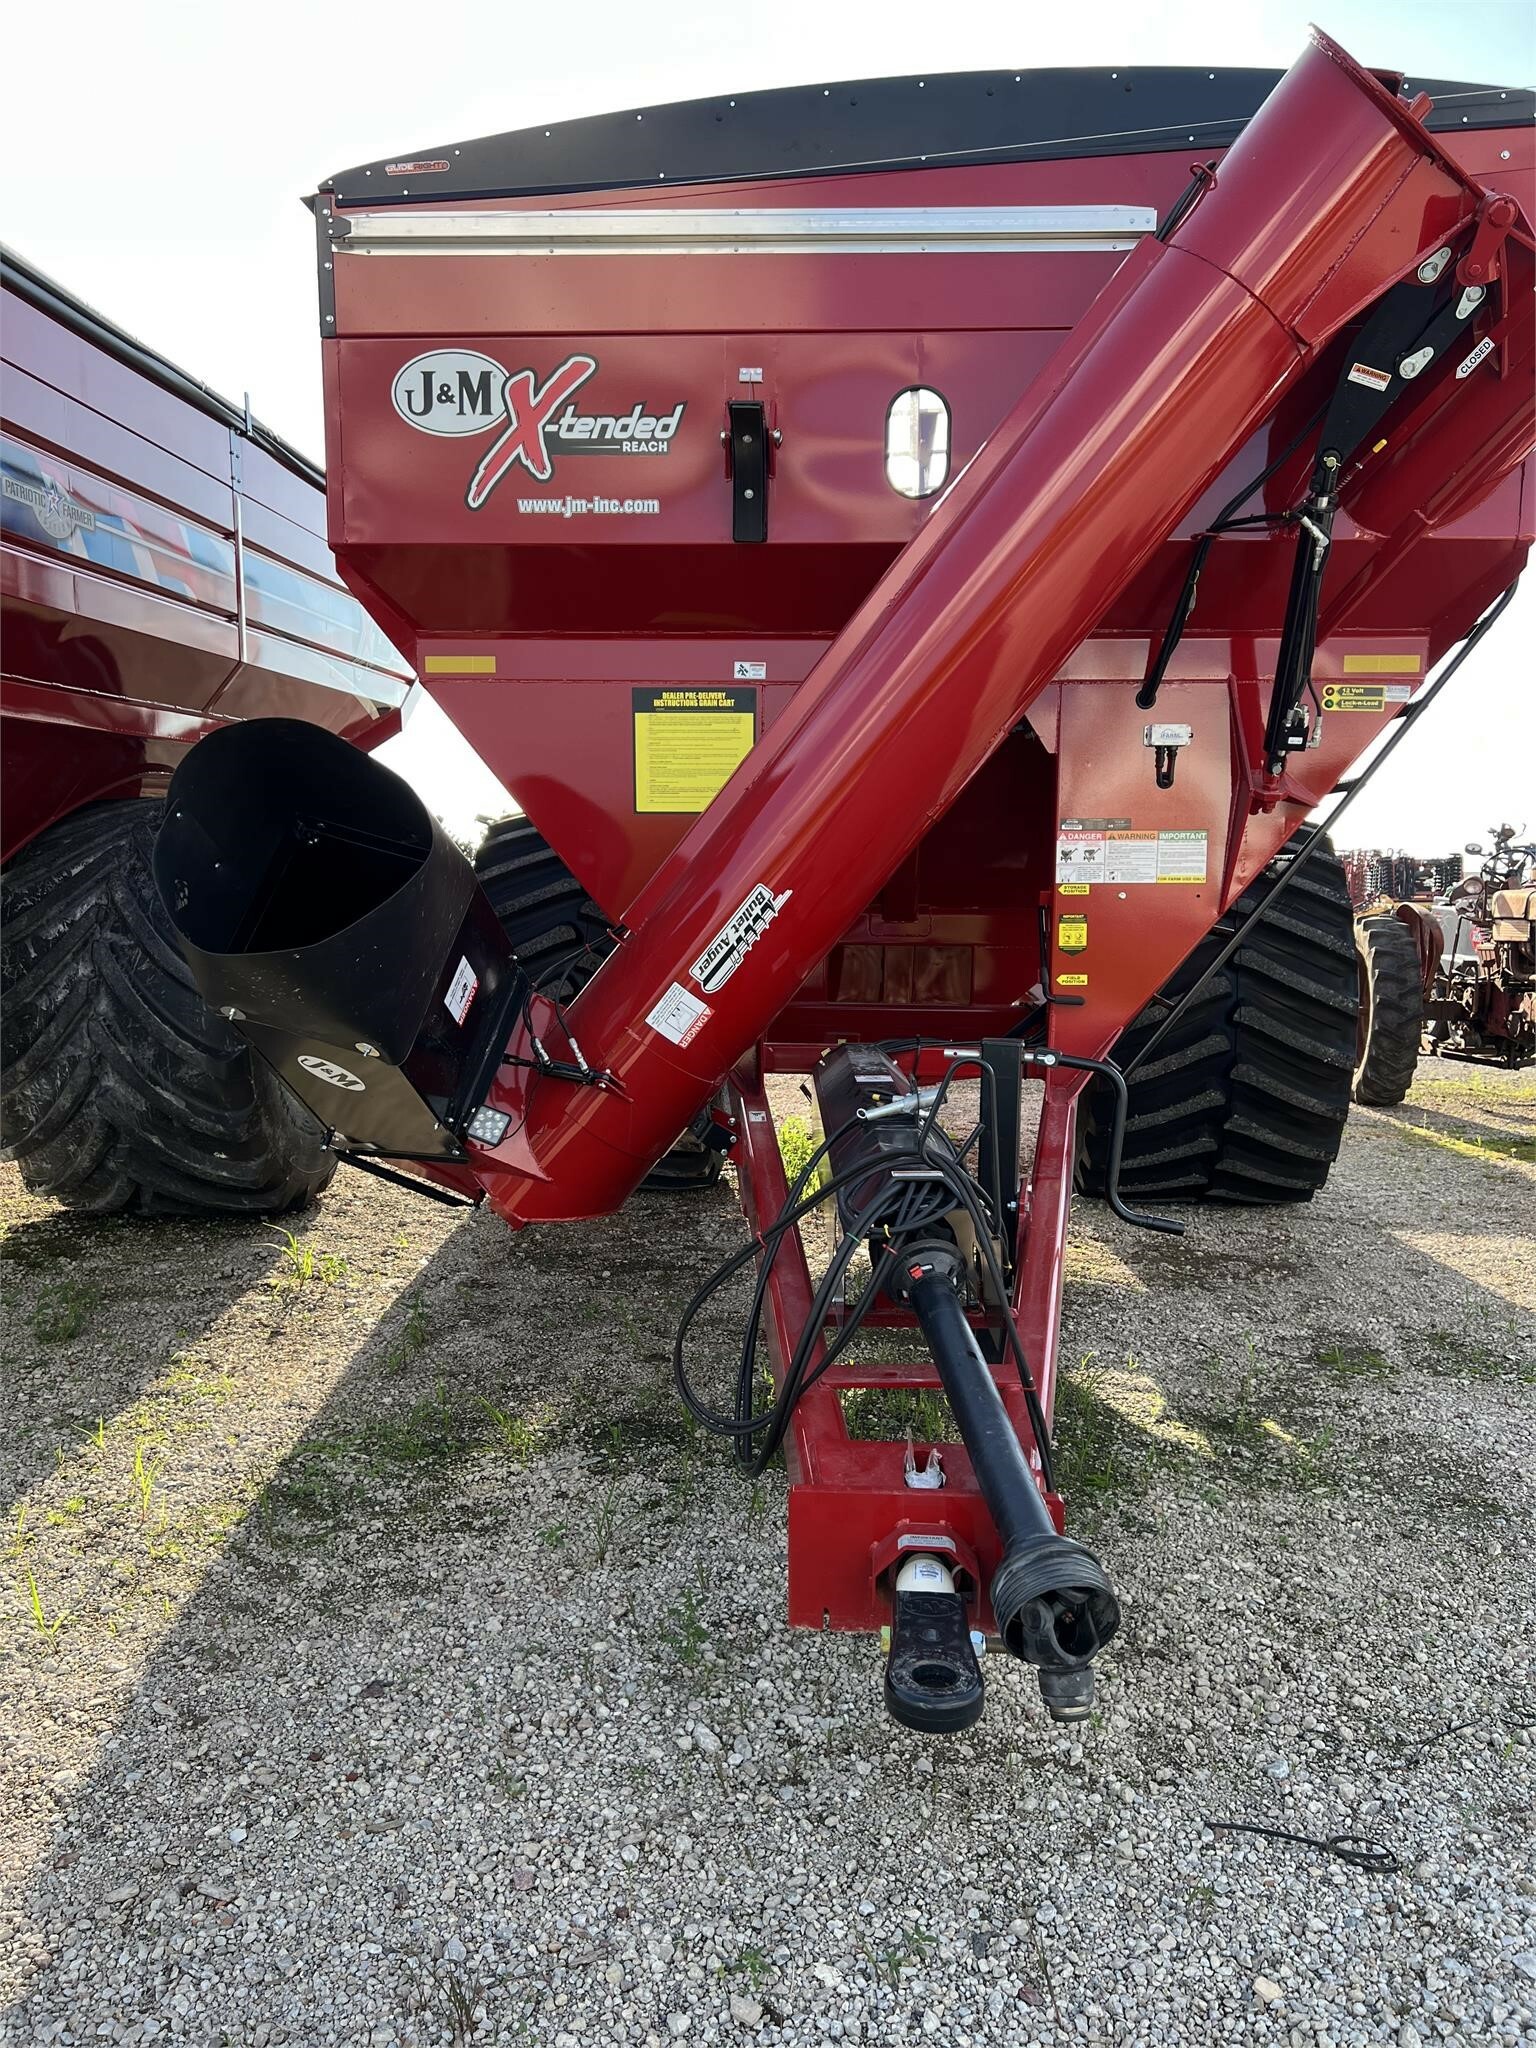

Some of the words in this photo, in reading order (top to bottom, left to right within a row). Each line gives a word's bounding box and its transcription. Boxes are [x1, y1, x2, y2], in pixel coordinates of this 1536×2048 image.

[1460, 341, 1491, 374] CLOSED
[1361, 368, 1387, 381] WARNING
[404, 370, 493, 416] J&M
[622, 441, 668, 452] REACH
[5, 479, 46, 508] PATRIOTIC
[62, 502, 93, 526] FARMER
[517, 496, 660, 518] www.jm-inc.com
[653, 699, 698, 707] INSTRUCTIONS
[699, 699, 718, 707] GRAIN
[719, 699, 735, 707] CART
[662, 692, 684, 700] DEALER
[685, 692, 726, 700] PRE-DELIVERY
[1117, 832, 1156, 840] WARNING
[1159, 832, 1207, 840] IMPORTANT
[731, 890, 766, 934] Bullet
[698, 932, 733, 977] Auger
[458, 988, 476, 1025] DANGER
[680, 1015, 708, 1048] DANGER
[300, 1057, 362, 1088] J&M
